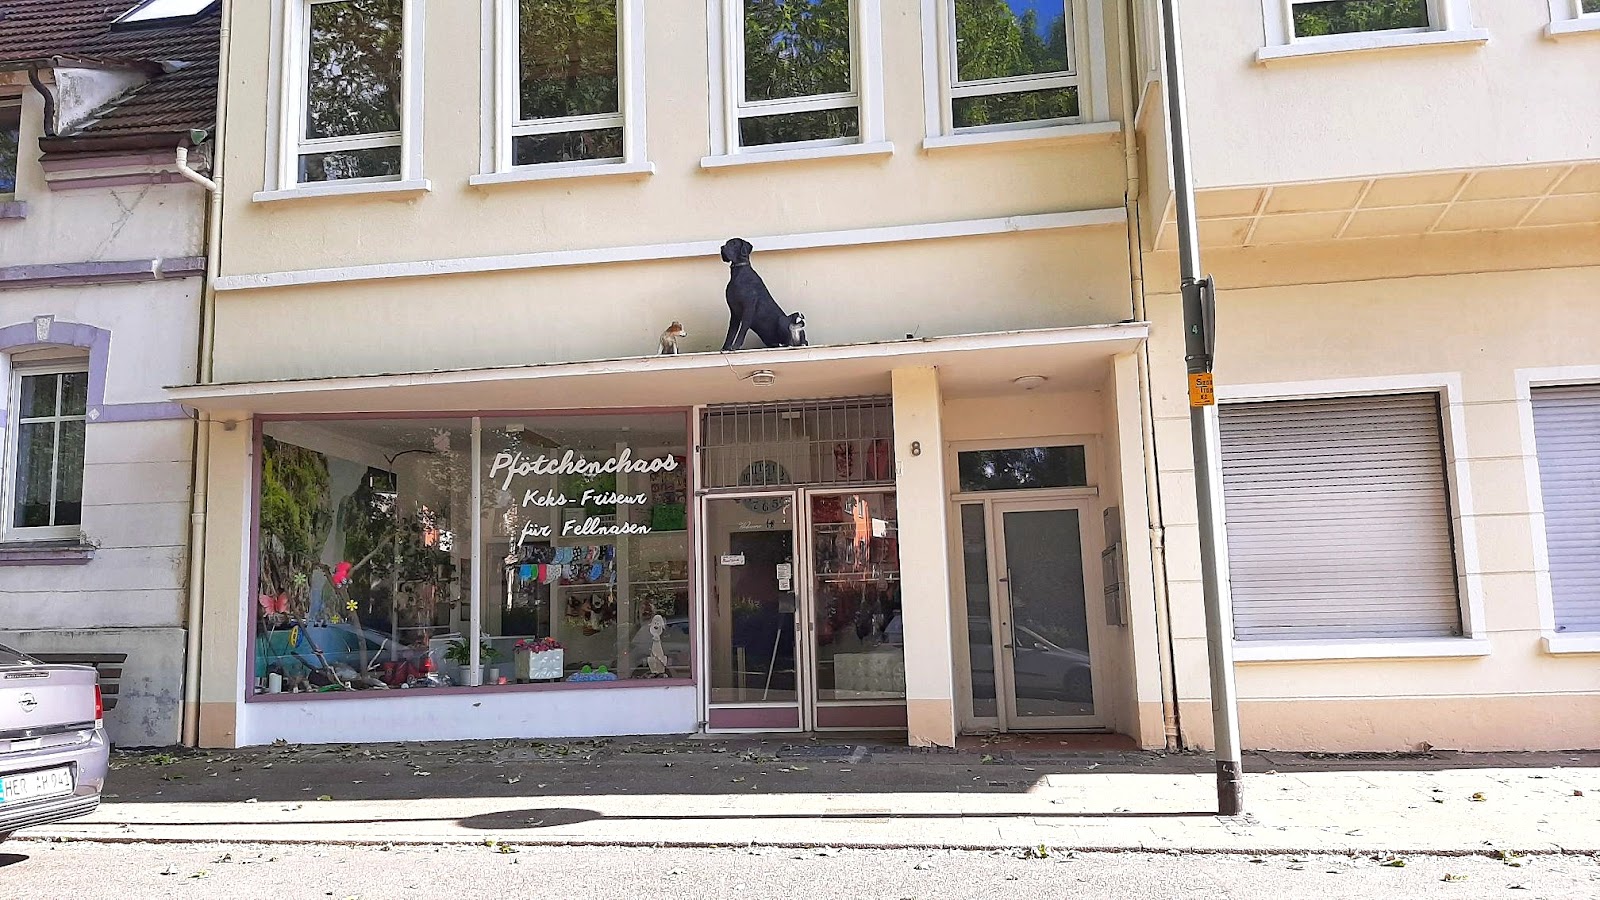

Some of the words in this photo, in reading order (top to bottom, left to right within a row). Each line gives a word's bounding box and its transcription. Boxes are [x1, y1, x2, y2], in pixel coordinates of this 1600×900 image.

[1192, 324, 1199, 334] 4
[910, 441, 921, 457] 8
[489, 447, 679, 491] Pfötchenchaos
[516, 519, 552, 547] für
[561, 516, 652, 536] Fellnasen
[5, 778, 28, 797] HER
